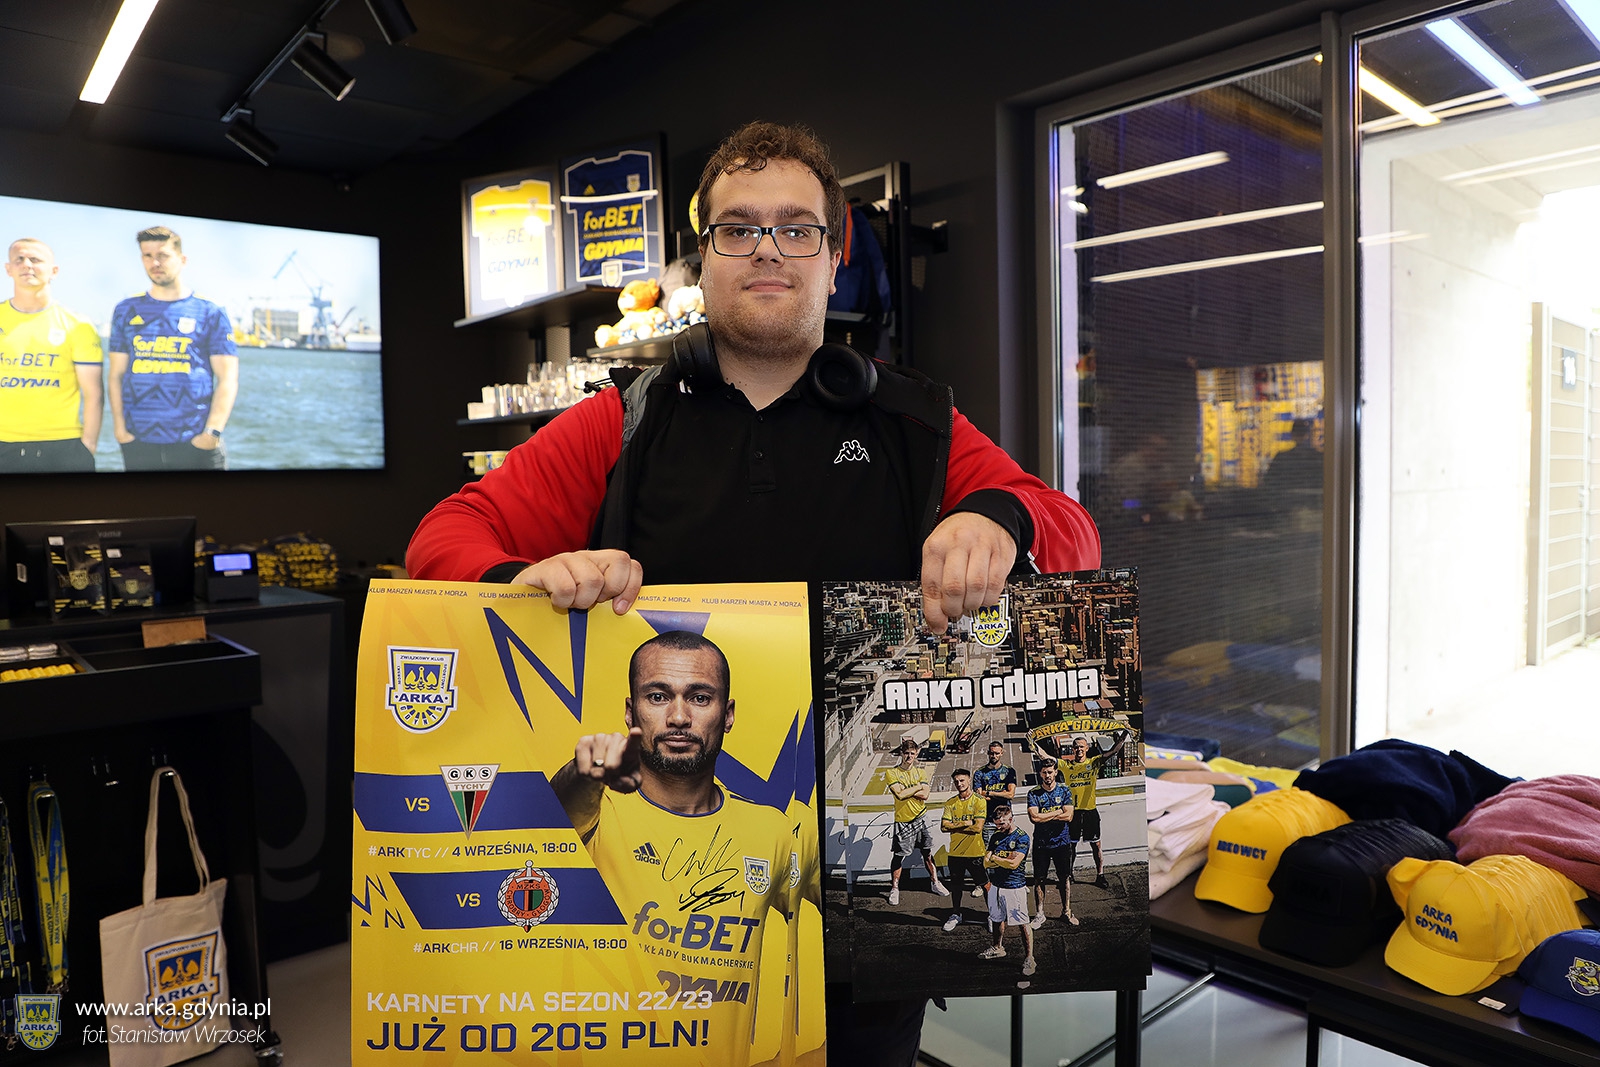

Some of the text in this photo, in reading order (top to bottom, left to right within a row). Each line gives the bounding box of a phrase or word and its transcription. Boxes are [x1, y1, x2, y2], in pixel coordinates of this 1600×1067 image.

[583, 204, 642, 231] forBET
[583, 238, 644, 261] GDYNIA
[0, 352, 59, 367] forBET
[1, 377, 60, 388] GDYNIA
[414, 588, 437, 596] MIASTA
[479, 591, 496, 599] KLUB
[399, 693, 444, 703] ARKA
[884, 678, 973, 710] ARKA
[1035, 720, 1069, 739] ARKA
[450, 769, 489, 779] GKS
[404, 797, 430, 812] VS
[368, 846, 431, 859] #ARKTYC
[452, 846, 461, 857] 4
[464, 842, 538, 856] WRZEŚNIA,
[542, 842, 578, 854] 18:00
[634, 853, 661, 866] adidas
[456, 892, 481, 908] VS
[1422, 904, 1452, 926] ARKA
[632, 901, 760, 954] forBET
[1416, 915, 1458, 943] GDYNIA
[413, 942, 478, 954] #ARKCHR
[500, 939, 514, 950] 16
[517, 936, 589, 950] WRZEŚNIA,
[592, 938, 628, 950] 18:00
[681, 953, 754, 970] BUKMACHERSKIE
[157, 983, 208, 1004] ARKA
[366, 990, 713, 1014] KARNETY NA SEZON 22/23
[366, 1016, 710, 1052] JUŻ OD 205 PLN!
